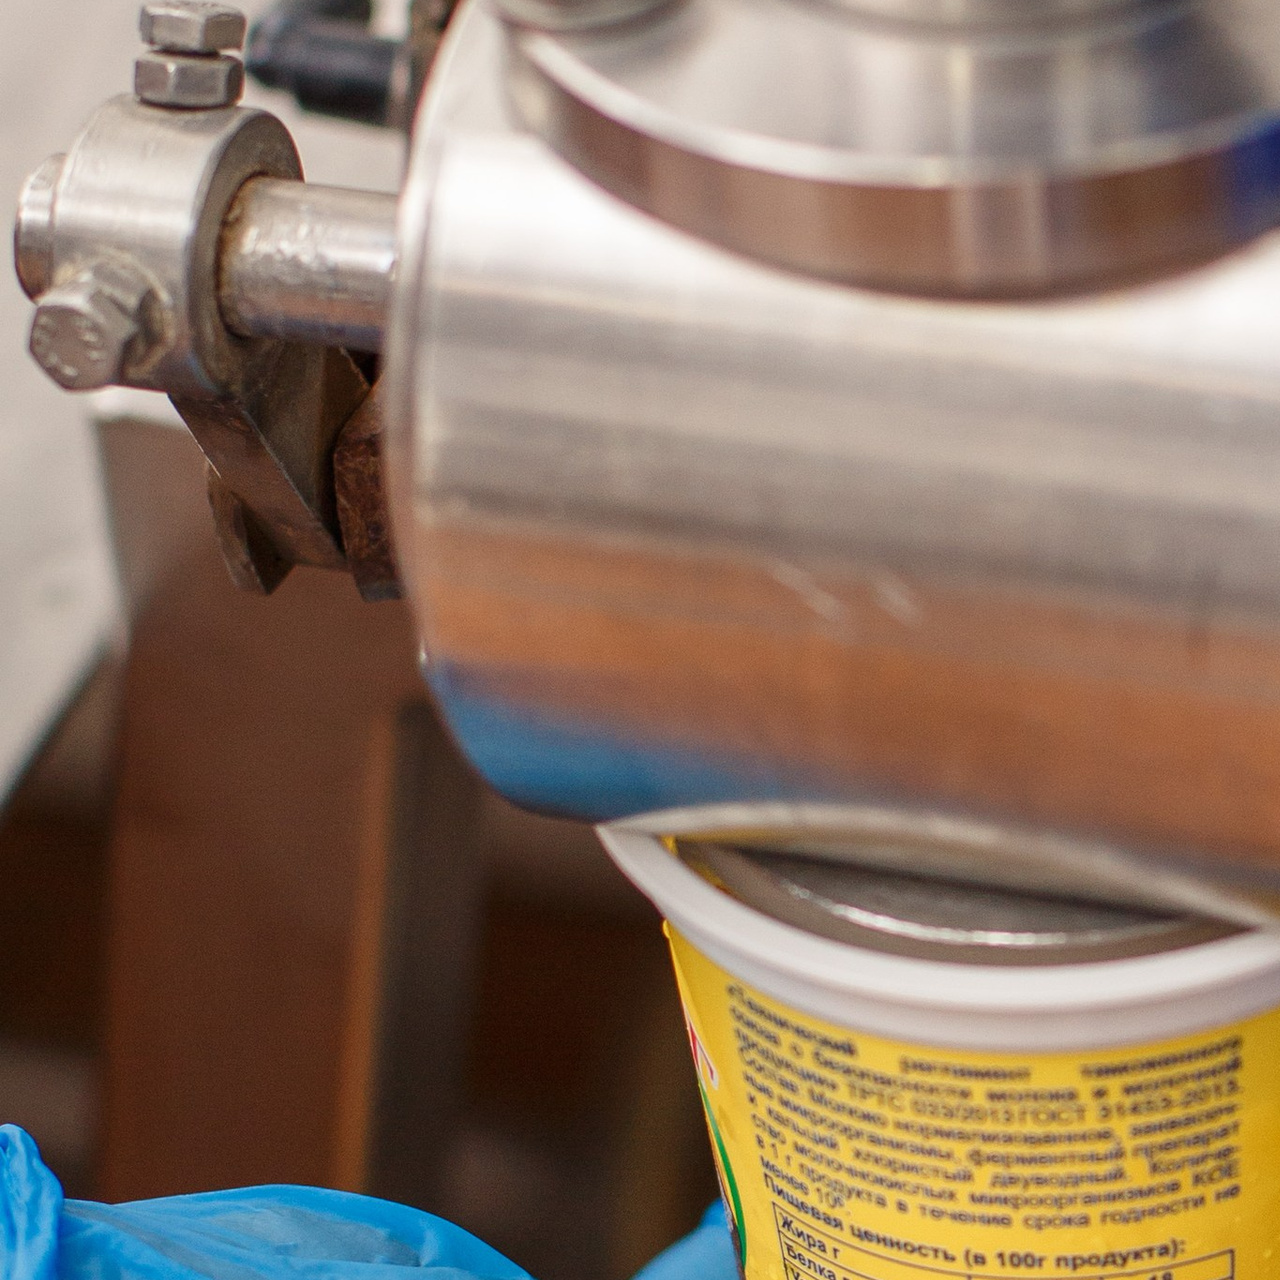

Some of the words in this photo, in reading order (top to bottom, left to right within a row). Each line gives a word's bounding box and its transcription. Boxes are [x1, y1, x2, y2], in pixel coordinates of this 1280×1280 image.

[764, 1173, 844, 1230] Пищевая
[850, 1224, 957, 1264] ценность
[964, 1248, 987, 1269] (в
[995, 1251, 1047, 1270] 100г
[1055, 1239, 1186, 1271] продукта):
[779, 1212, 828, 1254] Жира
[832, 1247, 841, 1259] г
[1022, 1213, 1091, 1231] срока
[1101, 1194, 1206, 1225] годности
